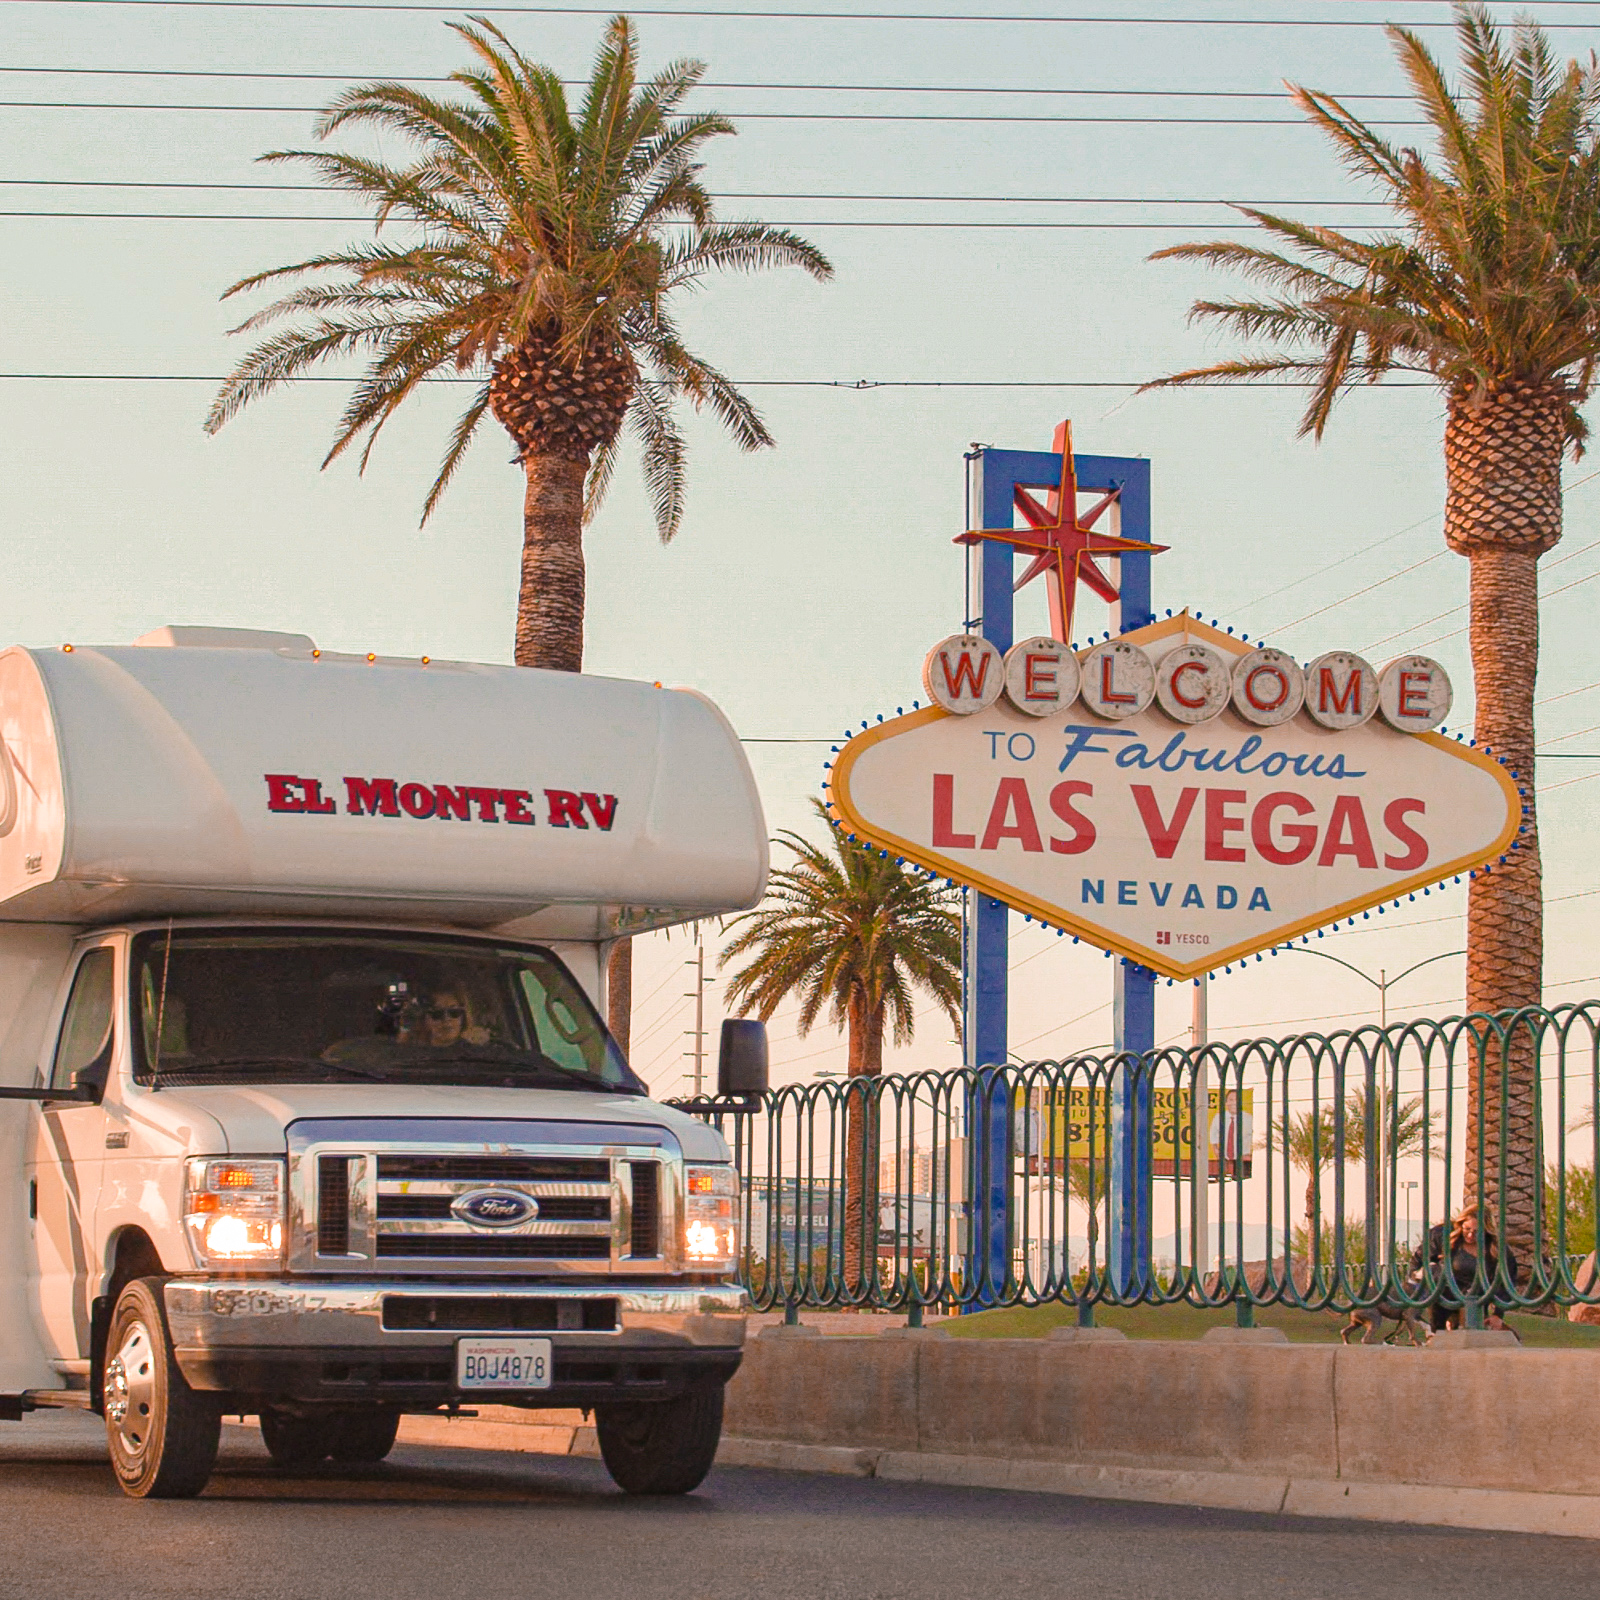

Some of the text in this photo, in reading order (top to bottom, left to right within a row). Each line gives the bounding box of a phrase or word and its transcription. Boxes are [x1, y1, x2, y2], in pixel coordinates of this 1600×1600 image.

[939, 651, 1432, 719] WELCOME
[982, 724, 1367, 780] TO Fabulous
[265, 774, 619, 832] EL MONTE RV
[932, 773, 1430, 871] LAS VEGAS
[1081, 878, 1272, 912] NEVADA
[1175, 933, 1210, 945] YESCO
[480, 1198, 518, 1215] Ford
